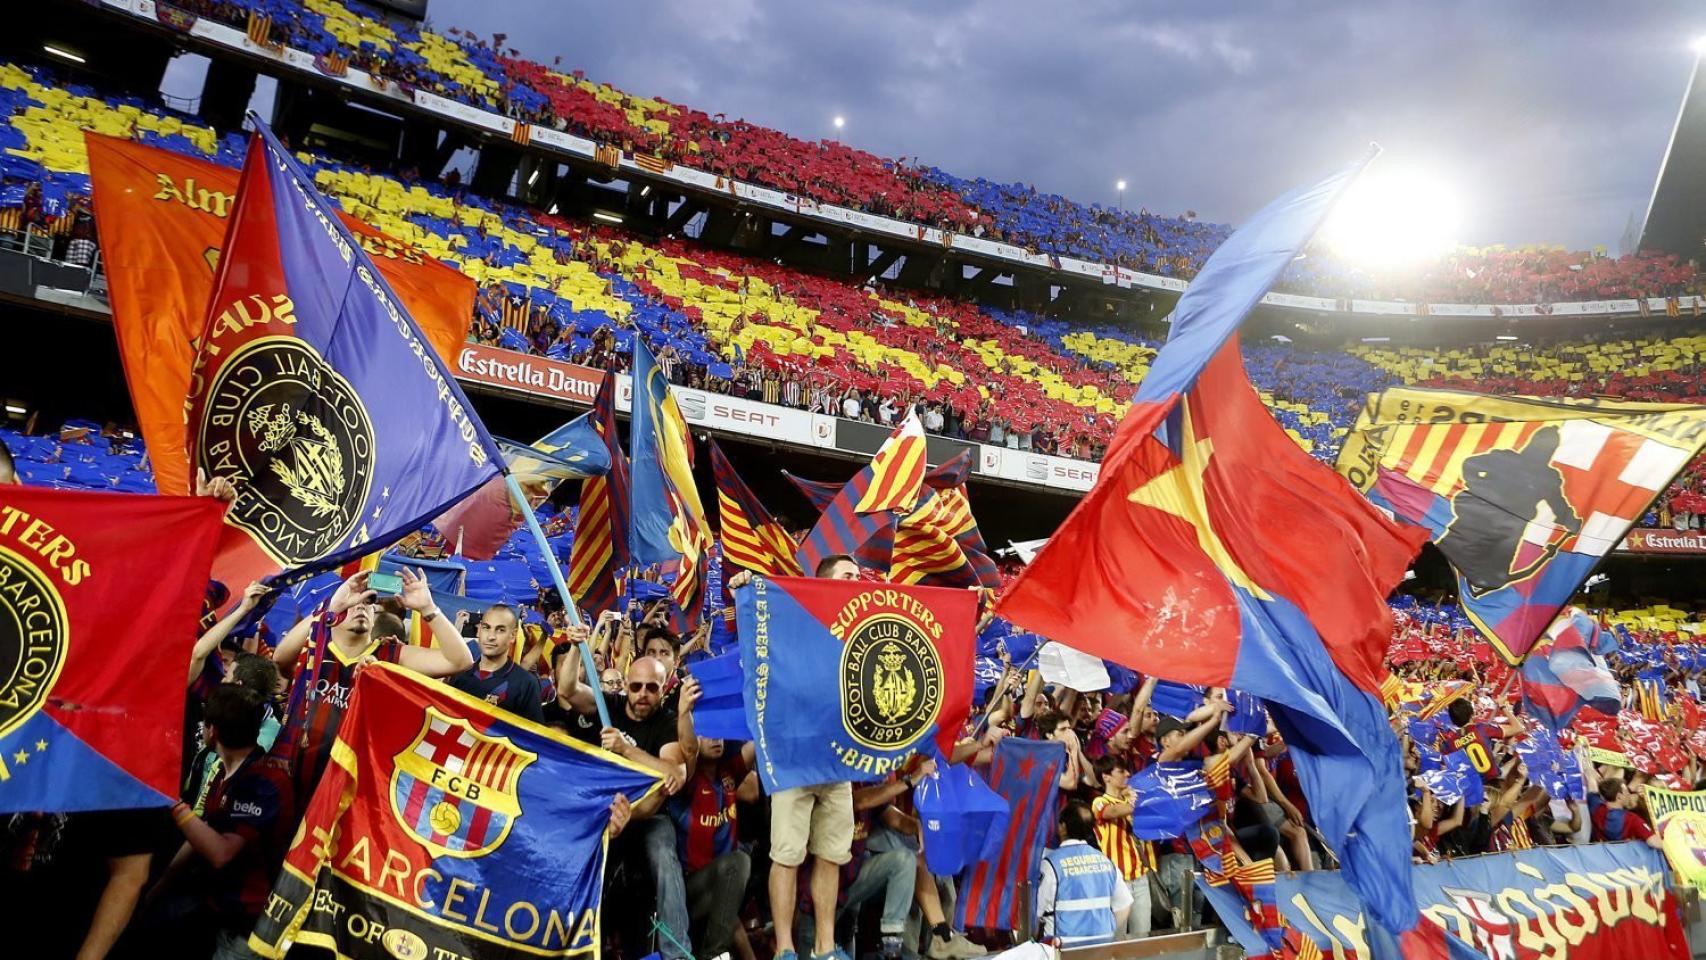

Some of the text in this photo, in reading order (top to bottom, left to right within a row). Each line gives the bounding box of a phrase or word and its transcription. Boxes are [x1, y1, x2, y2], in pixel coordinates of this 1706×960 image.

[458, 347, 601, 397] Estrella Dam
[713, 404, 781, 428] SEAT
[1054, 466, 1098, 482] SEA
[1646, 533, 1698, 549] Estrella
[830, 589, 944, 640] SUPPORTERS
[868, 623, 900, 640] CLUB
[904, 629, 938, 722] BARCELONA
[869, 727, 903, 742] 1899
[430, 768, 481, 801] FCB
[233, 800, 262, 816] beko
[1648, 789, 1706, 820] CAMPIO
[347, 913, 386, 945] OF
